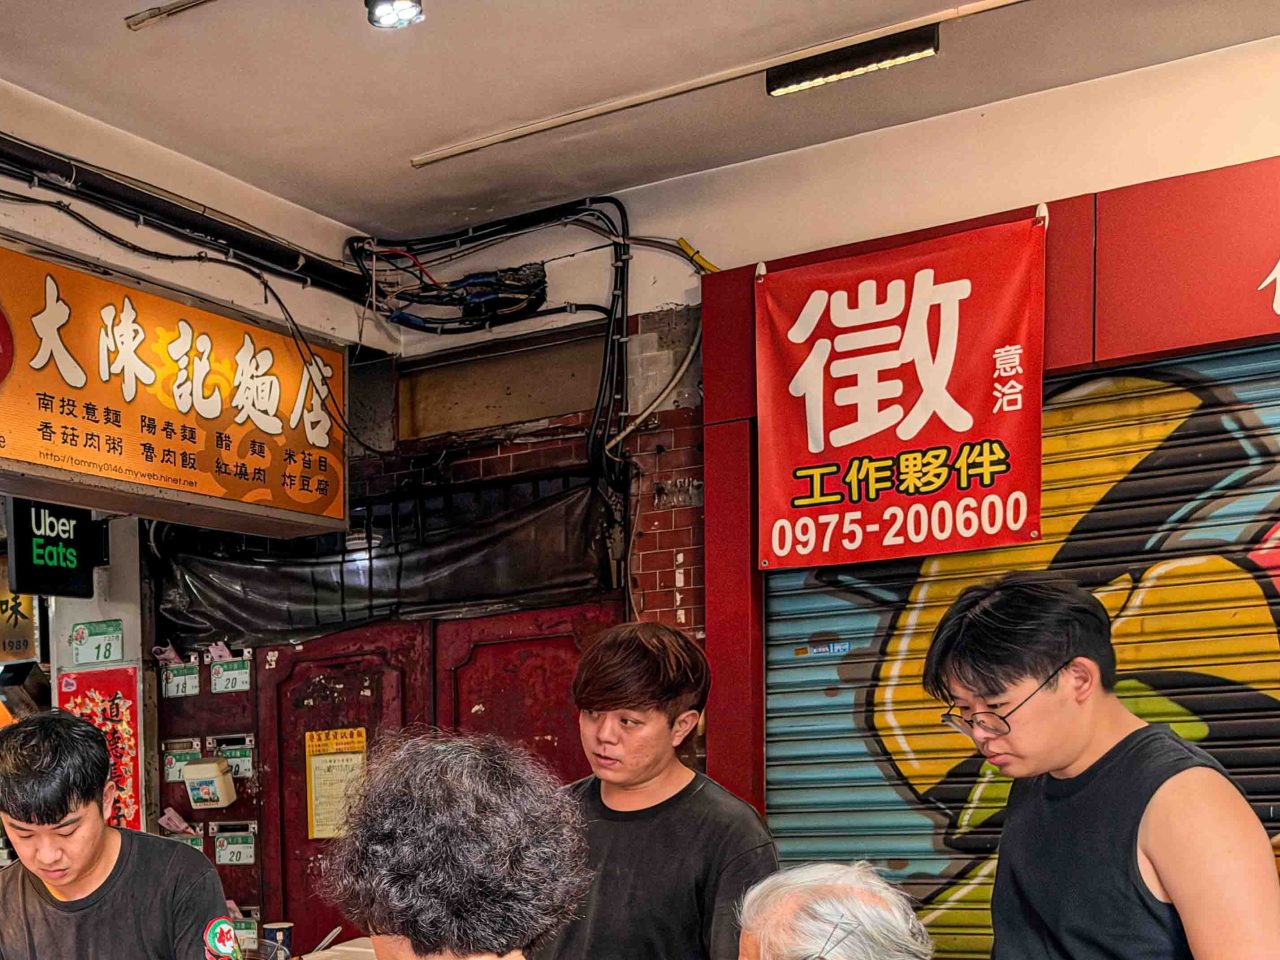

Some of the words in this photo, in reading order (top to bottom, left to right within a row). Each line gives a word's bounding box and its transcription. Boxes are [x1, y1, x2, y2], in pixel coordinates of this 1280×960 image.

[29, 272, 333, 448] 大陳記麵店
[787, 268, 974, 455] 徵
[35, 391, 122, 429] 南投意麵
[140, 414, 197, 445] 陽春麵
[283, 447, 328, 473] 米苔目
[35, 420, 123, 456] 香菇肉粥
[140, 441, 197, 471] 魯肉飯
[215, 457, 266, 484] 紅燒肉
[281, 472, 329, 497] 炸豆腐
[792, 439, 1010, 510] 工作夥伴
[31, 507, 77, 539] Uber
[771, 490, 1028, 557] 0975-200600
[32, 537, 77, 568] Eats
[2, 640, 29, 652] 1989
[94, 642, 112, 660] 18
[175, 682, 186, 694] 18
[224, 677, 237, 690] 20
[228, 850, 242, 862] 20
